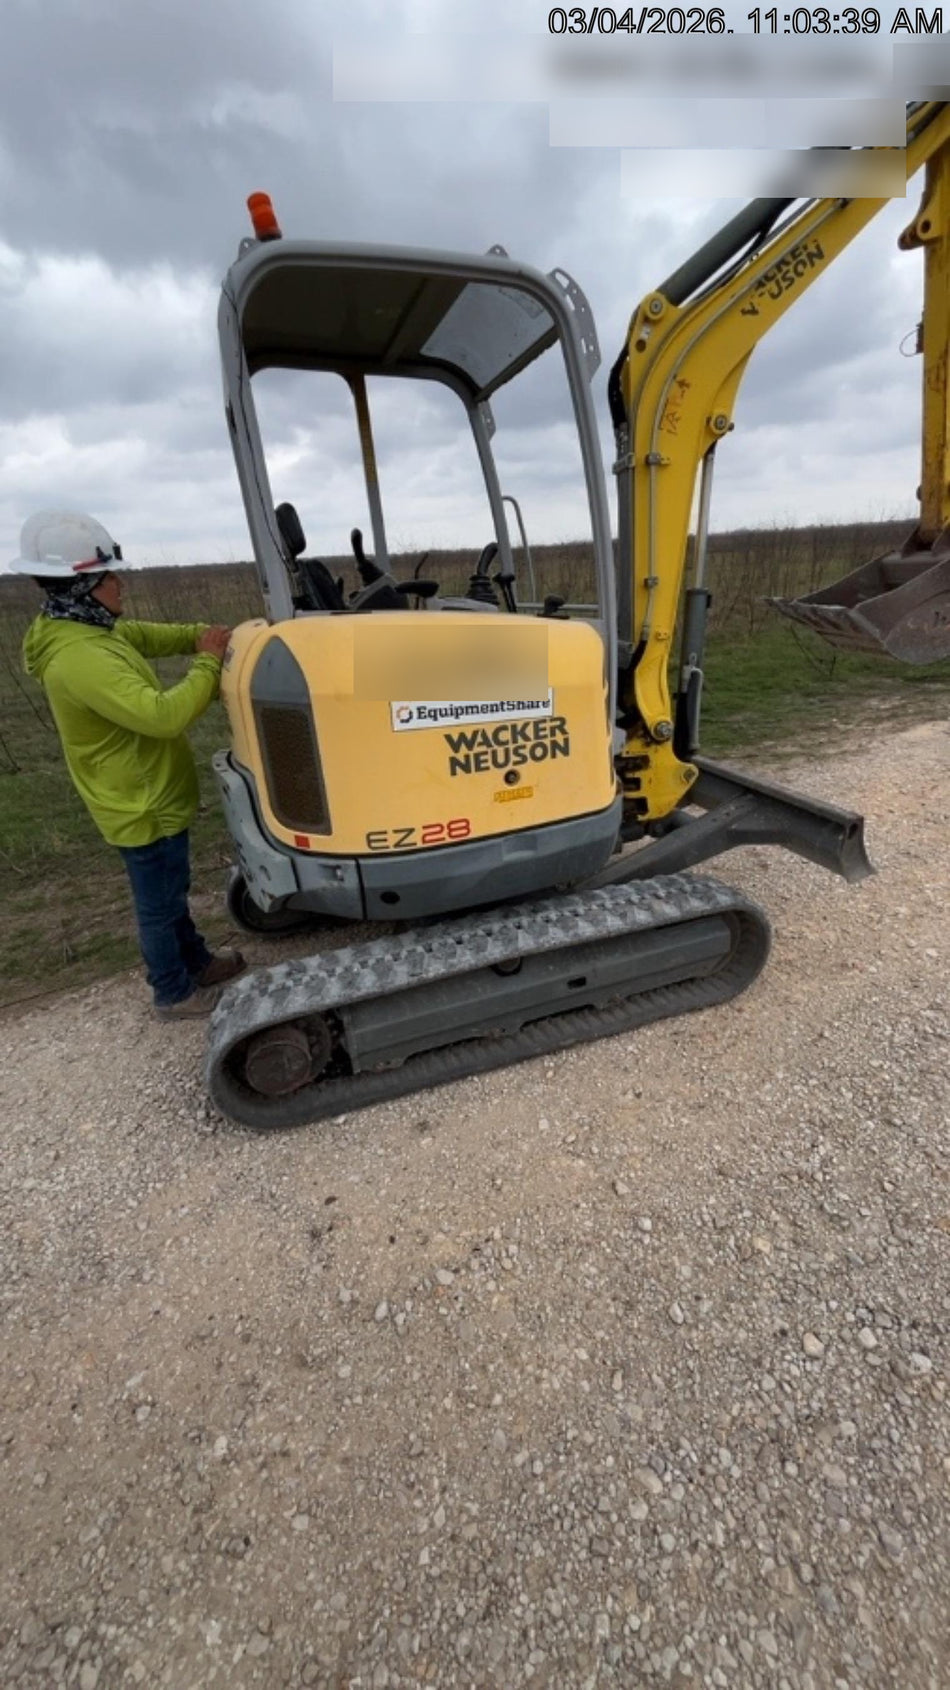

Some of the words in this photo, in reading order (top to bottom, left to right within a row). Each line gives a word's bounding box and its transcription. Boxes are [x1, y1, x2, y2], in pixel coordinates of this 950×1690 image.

[416, 700, 551, 721] EquipmentShare
[443, 716, 569, 754] WACKER
[449, 737, 570, 776] NEUSON
[366, 818, 471, 851] EZ28
